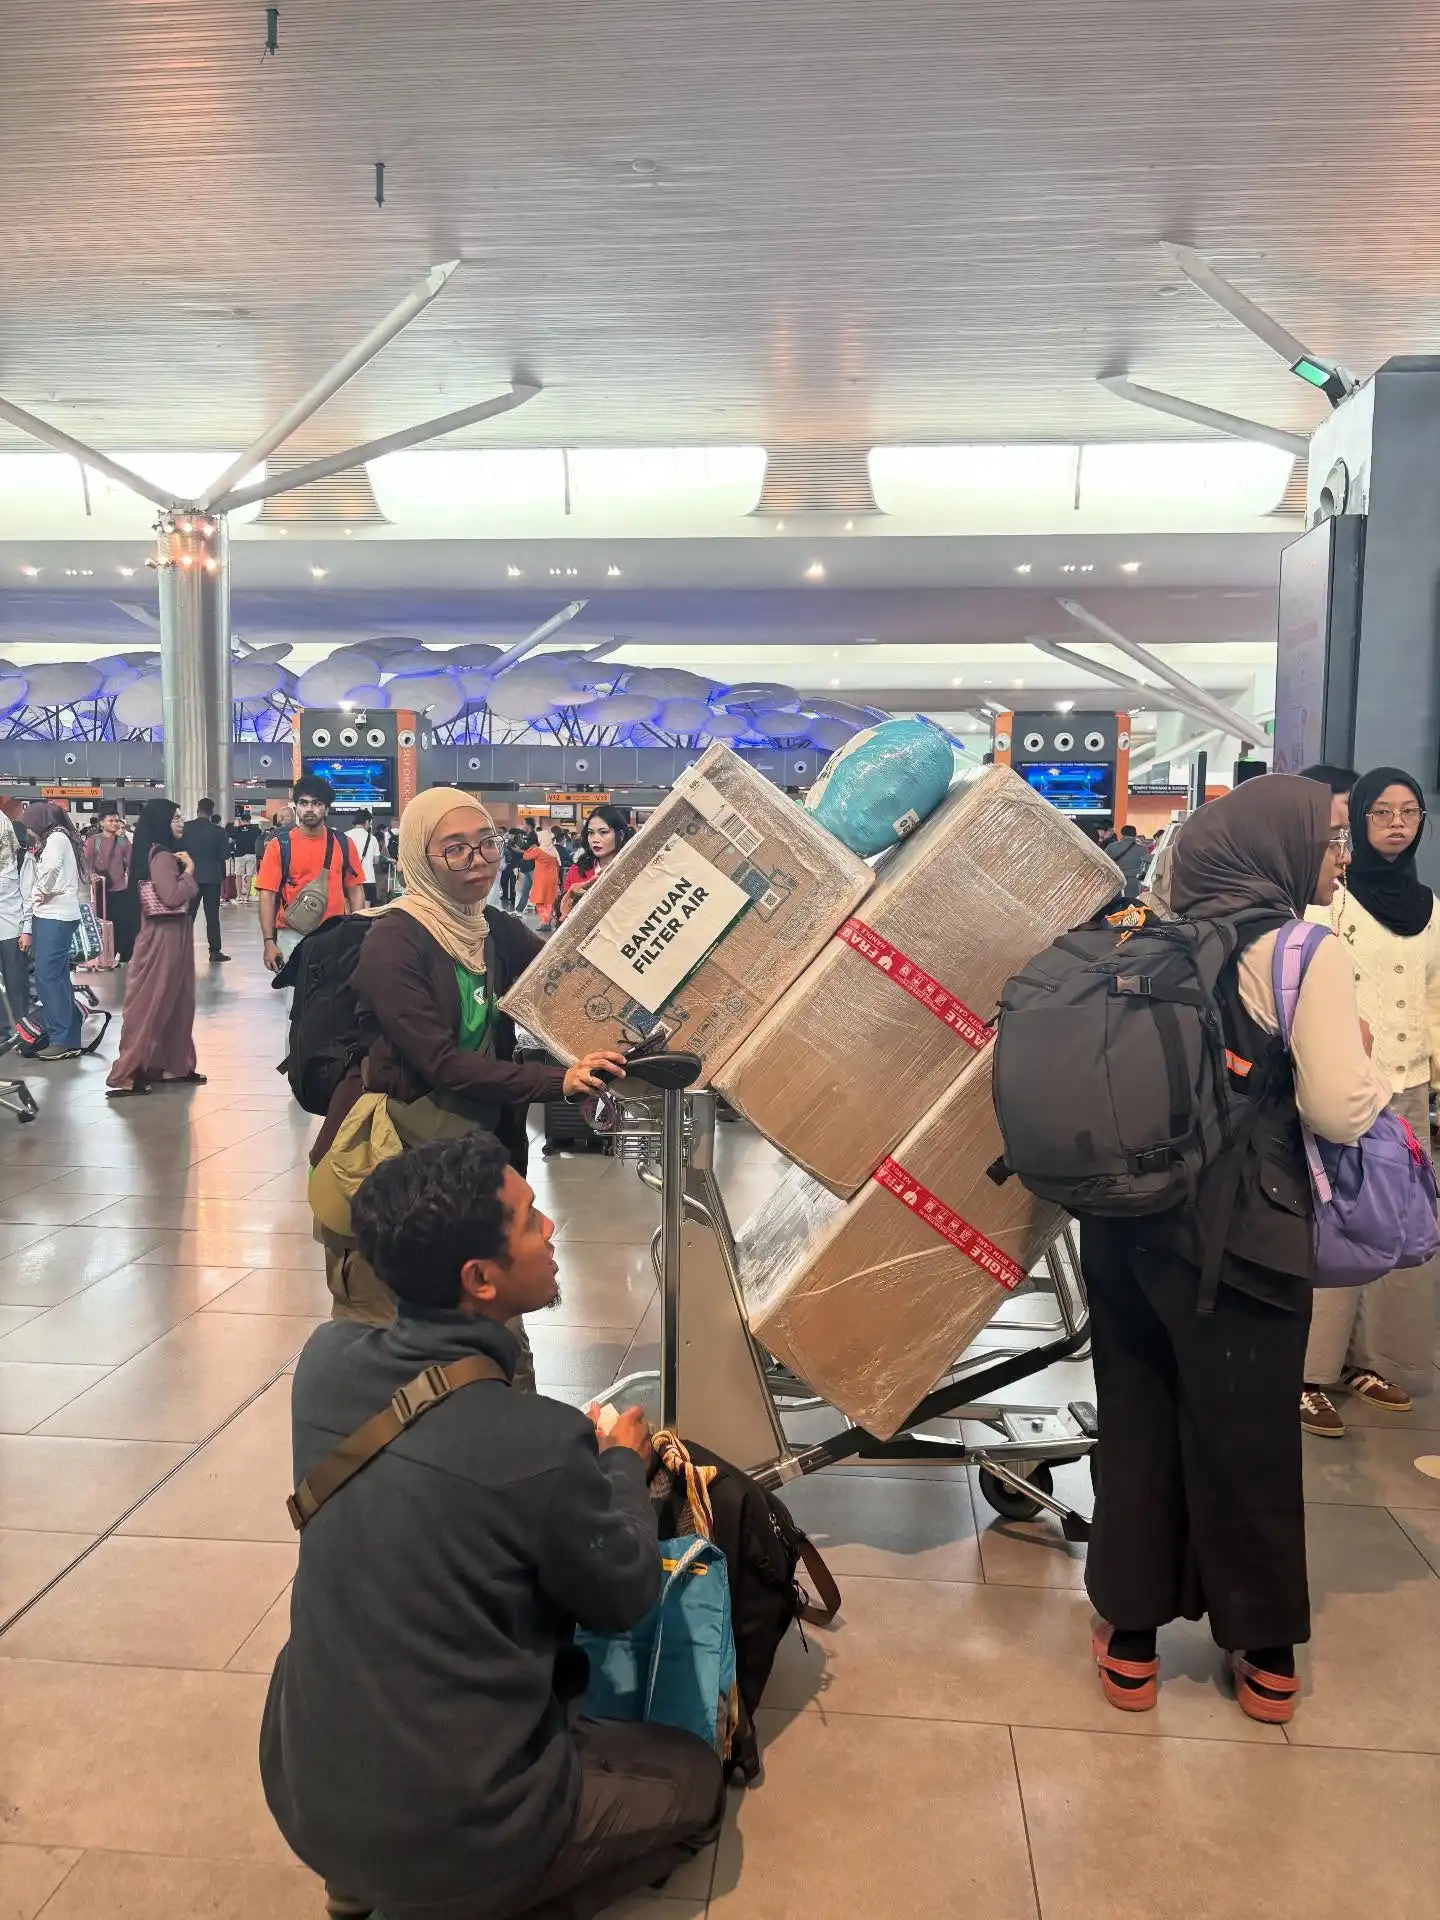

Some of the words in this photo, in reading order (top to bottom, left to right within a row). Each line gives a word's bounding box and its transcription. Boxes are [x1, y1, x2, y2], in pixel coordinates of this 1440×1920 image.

[620, 877, 693, 960] BANTUAN
[632, 917, 684, 975] FILTER
[681, 886, 709, 920] AIR
[860, 927, 887, 950] HANDLE
[950, 1001, 969, 1017] CARE
[943, 1010, 988, 1048] AGILE
[975, 1236, 994, 1252] CARE
[992, 1250, 1010, 1266] WITH
